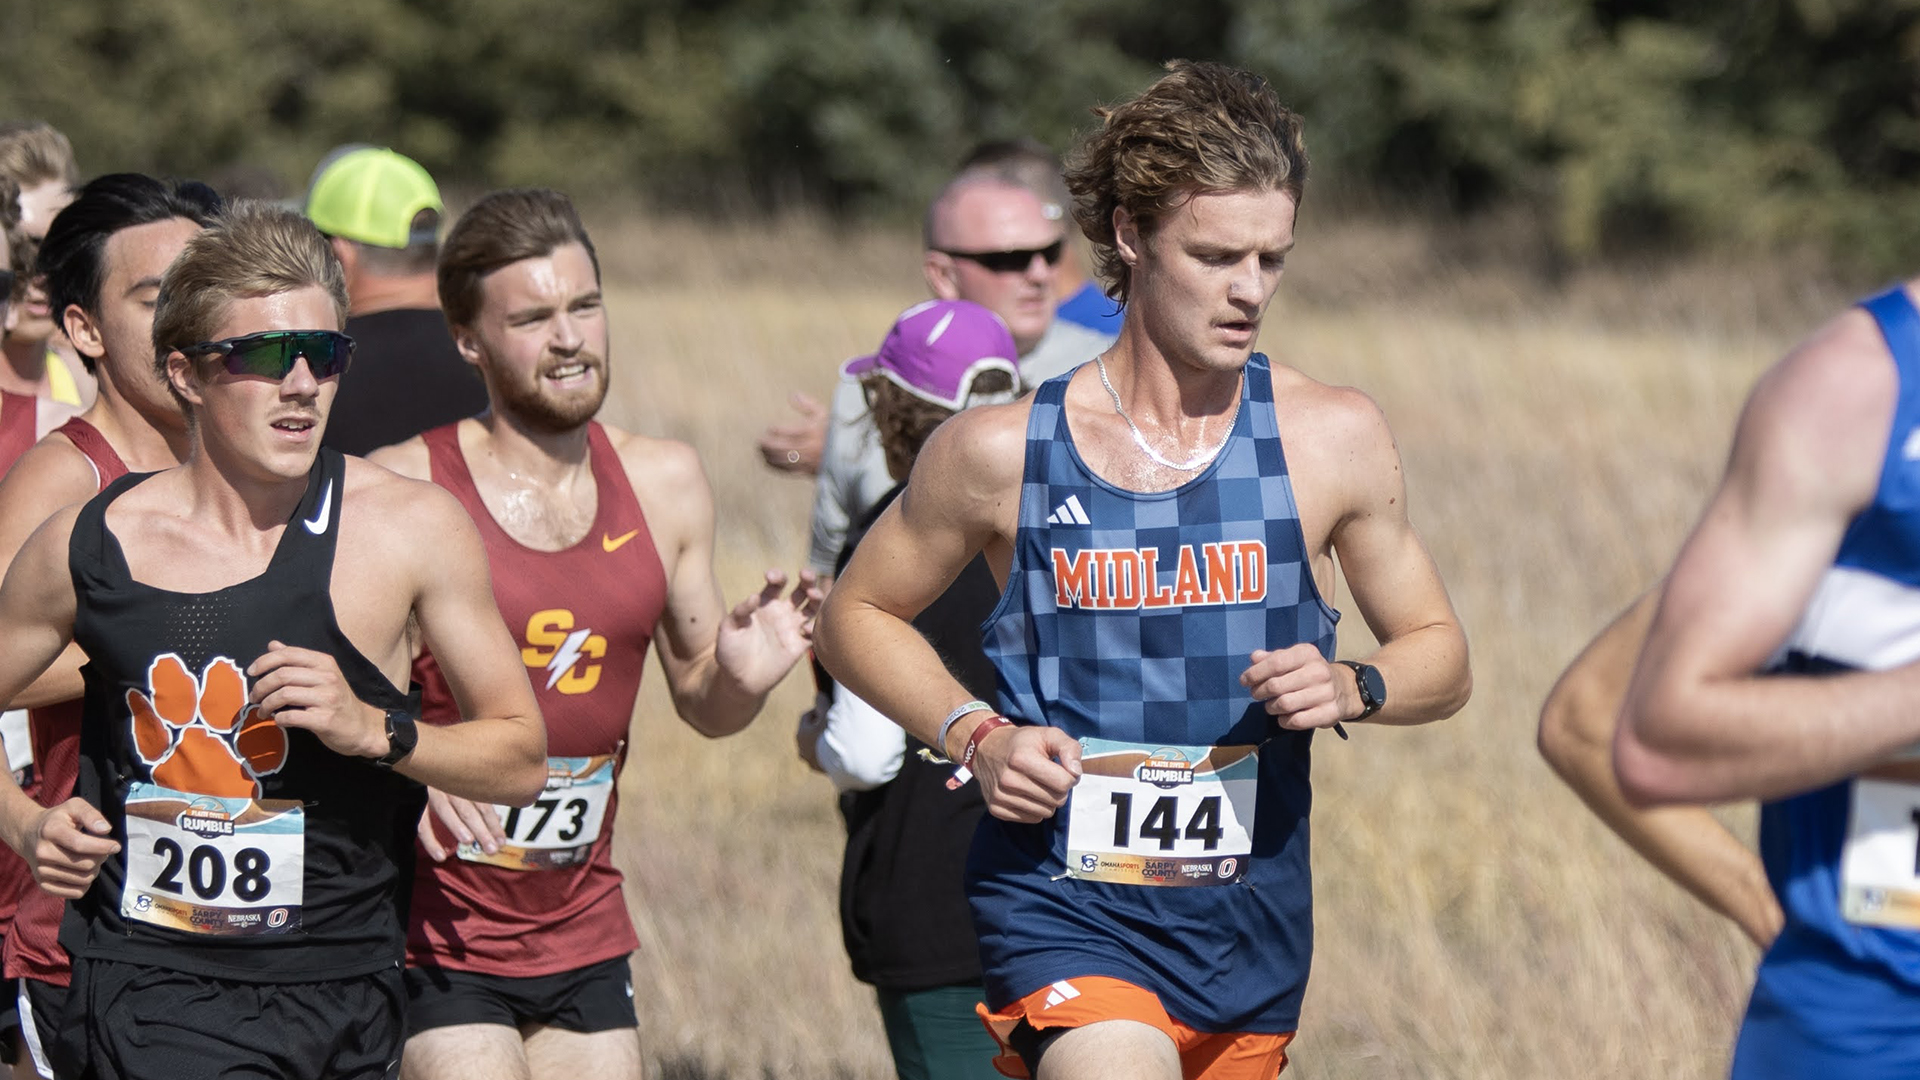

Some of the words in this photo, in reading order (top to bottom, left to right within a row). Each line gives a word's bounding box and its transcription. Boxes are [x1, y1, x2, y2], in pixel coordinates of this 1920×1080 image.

[1051, 540, 1267, 610] MIDLAND
[521, 608, 608, 695] SC
[1142, 768, 1193, 782] RUMBLE
[184, 818, 233, 833] RUMBLE
[505, 798, 588, 841] 173
[1110, 791, 1224, 852] 144
[151, 836, 272, 903] 208
[1145, 861, 1176, 869] SARPY
[1181, 863, 1213, 874] NEBRASKA
[1142, 868, 1178, 877] COUNTY
[192, 908, 223, 919] SARPY
[228, 914, 261, 923] NEBRASKA
[190, 916, 224, 926] COUNTY
